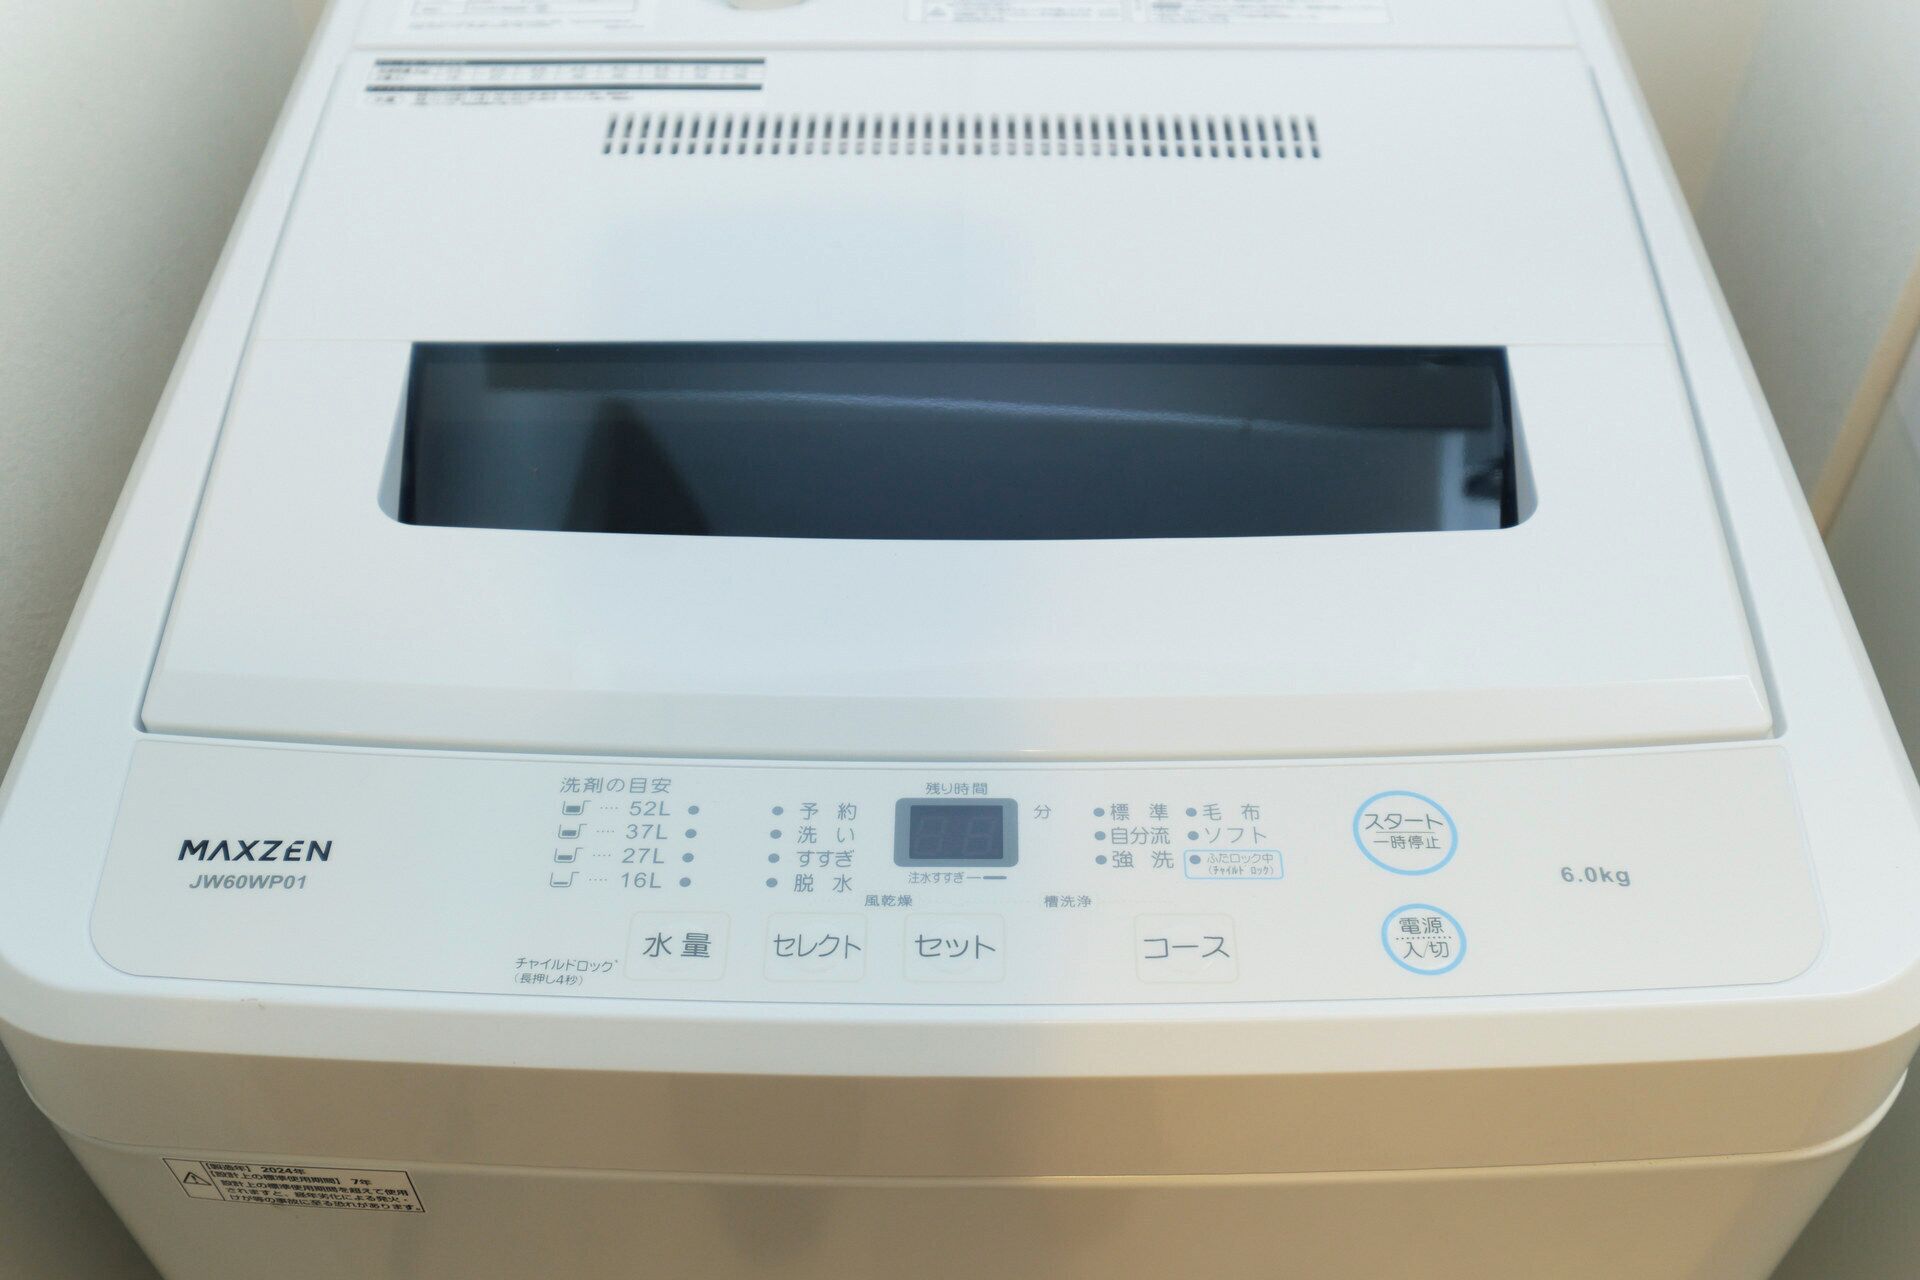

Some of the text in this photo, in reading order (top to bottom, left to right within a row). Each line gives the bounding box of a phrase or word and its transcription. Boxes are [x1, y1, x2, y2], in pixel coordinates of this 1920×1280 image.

[560, 777, 671, 793] 洗剤の目安
[925, 782, 988, 795] 残り時間
[629, 801, 670, 816] 52L
[800, 803, 857, 820] 予約
[1034, 804, 1051, 819] 分
[1110, 803, 1169, 821] 標準
[1203, 803, 1260, 821] 毛布
[1364, 813, 1443, 830] スタート
[626, 824, 667, 839] 37L
[797, 826, 855, 844] 洗い
[1111, 827, 1170, 845] 自分流
[1205, 827, 1267, 844] ソフト
[178, 839, 332, 861] MAXZEN
[1373, 835, 1441, 849] 一時停止
[622, 848, 664, 864] 27L
[797, 850, 854, 868] すすぎ
[1112, 851, 1174, 869] 強洗
[1207, 853, 1274, 864] ふたロック中
[189, 874, 306, 889] JW60WP01
[621, 872, 662, 888] 16L
[794, 874, 853, 892] 脱水
[908, 872, 964, 884] 注水すすぎ
[1561, 866, 1630, 887] 6.0kg
[864, 894, 913, 907] 風乾燥
[1043, 895, 1092, 908] 槽洗浄
[1399, 917, 1444, 934] 電源
[643, 932, 711, 958] 水量
[773, 933, 861, 959] セレクト
[915, 934, 996, 959] セット
[1143, 936, 1230, 959] コース
[1403, 941, 1450, 959] 入/切
